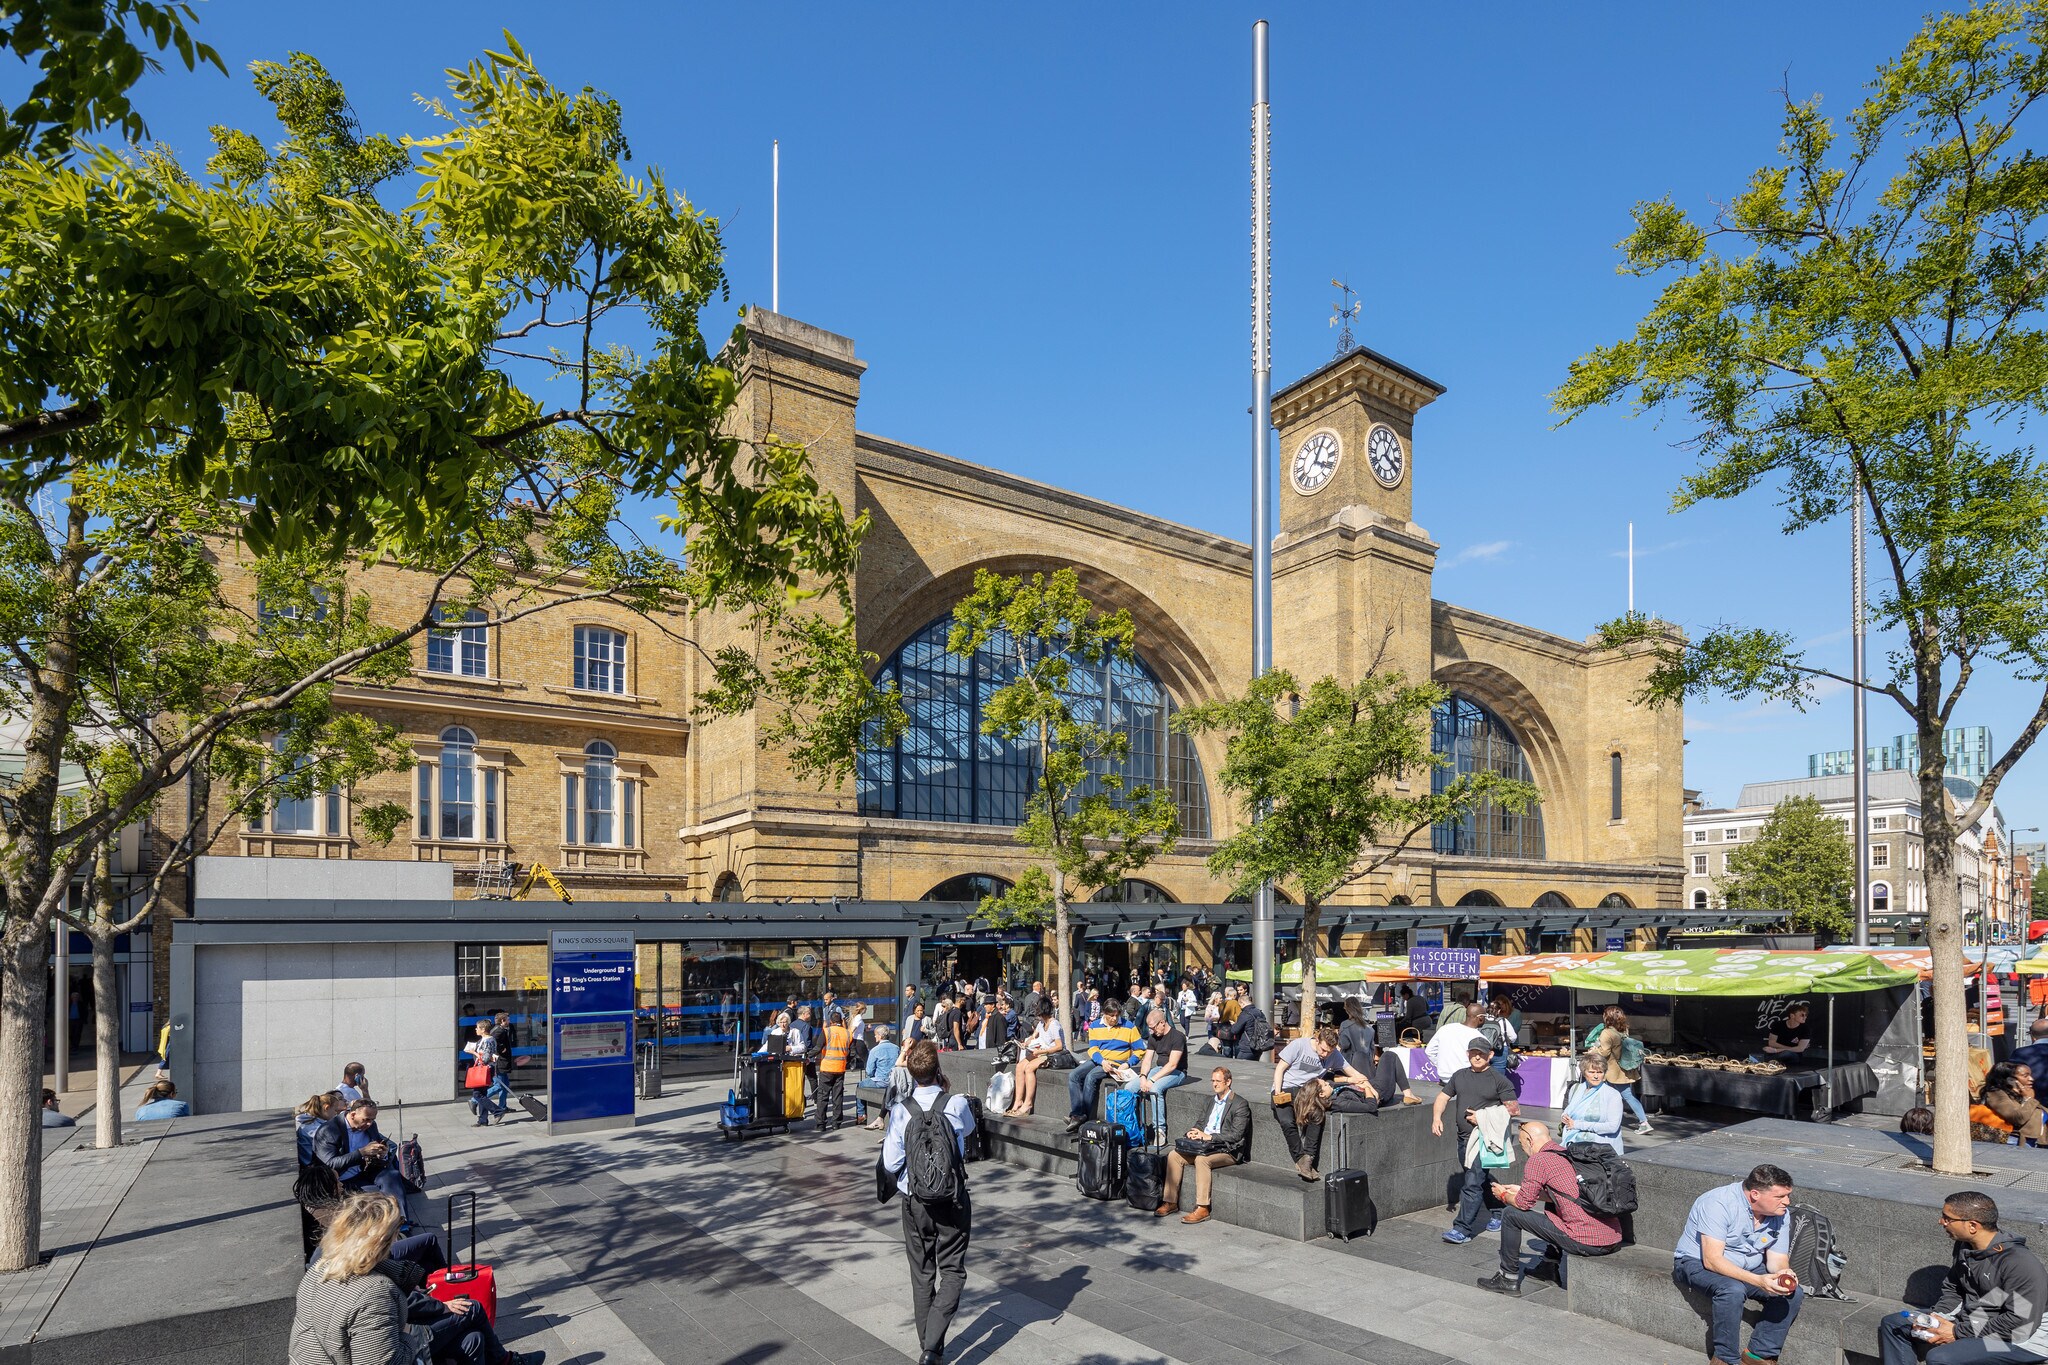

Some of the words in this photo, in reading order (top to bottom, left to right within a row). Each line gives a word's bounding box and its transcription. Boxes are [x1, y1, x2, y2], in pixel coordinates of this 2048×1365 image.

[1428, 951, 1476, 962] SCOTTISH
[1413, 962, 1476, 974] KITCHEN
[1510, 984, 1534, 1001] SCO
[1755, 1014, 1789, 1030] BO
[1301, 1054, 1321, 1066] LOND
